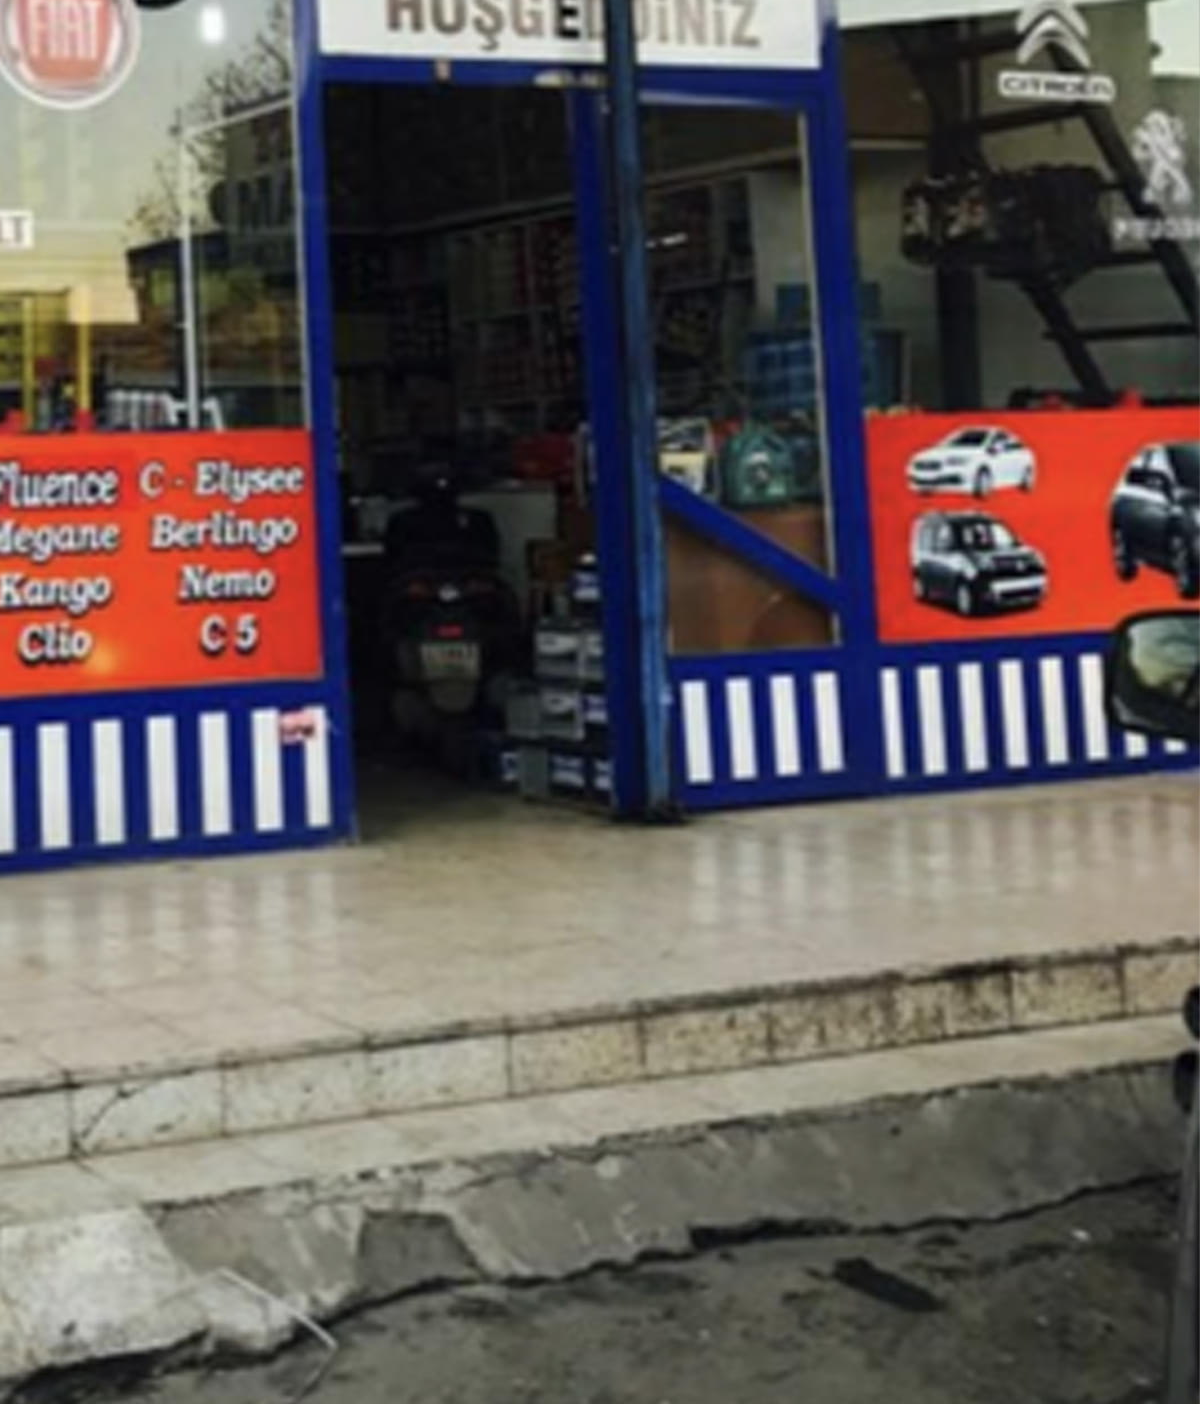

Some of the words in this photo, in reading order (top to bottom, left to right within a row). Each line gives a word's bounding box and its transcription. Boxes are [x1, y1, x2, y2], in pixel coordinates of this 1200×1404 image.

[139, 463, 164, 496] C
[196, 461, 304, 503] Elysee
[151, 509, 298, 553] Berlingo
[179, 565, 275, 600] Nemo
[17, 621, 93, 663] Clio
[200, 615, 227, 654] C
[236, 614, 259, 652] 5
